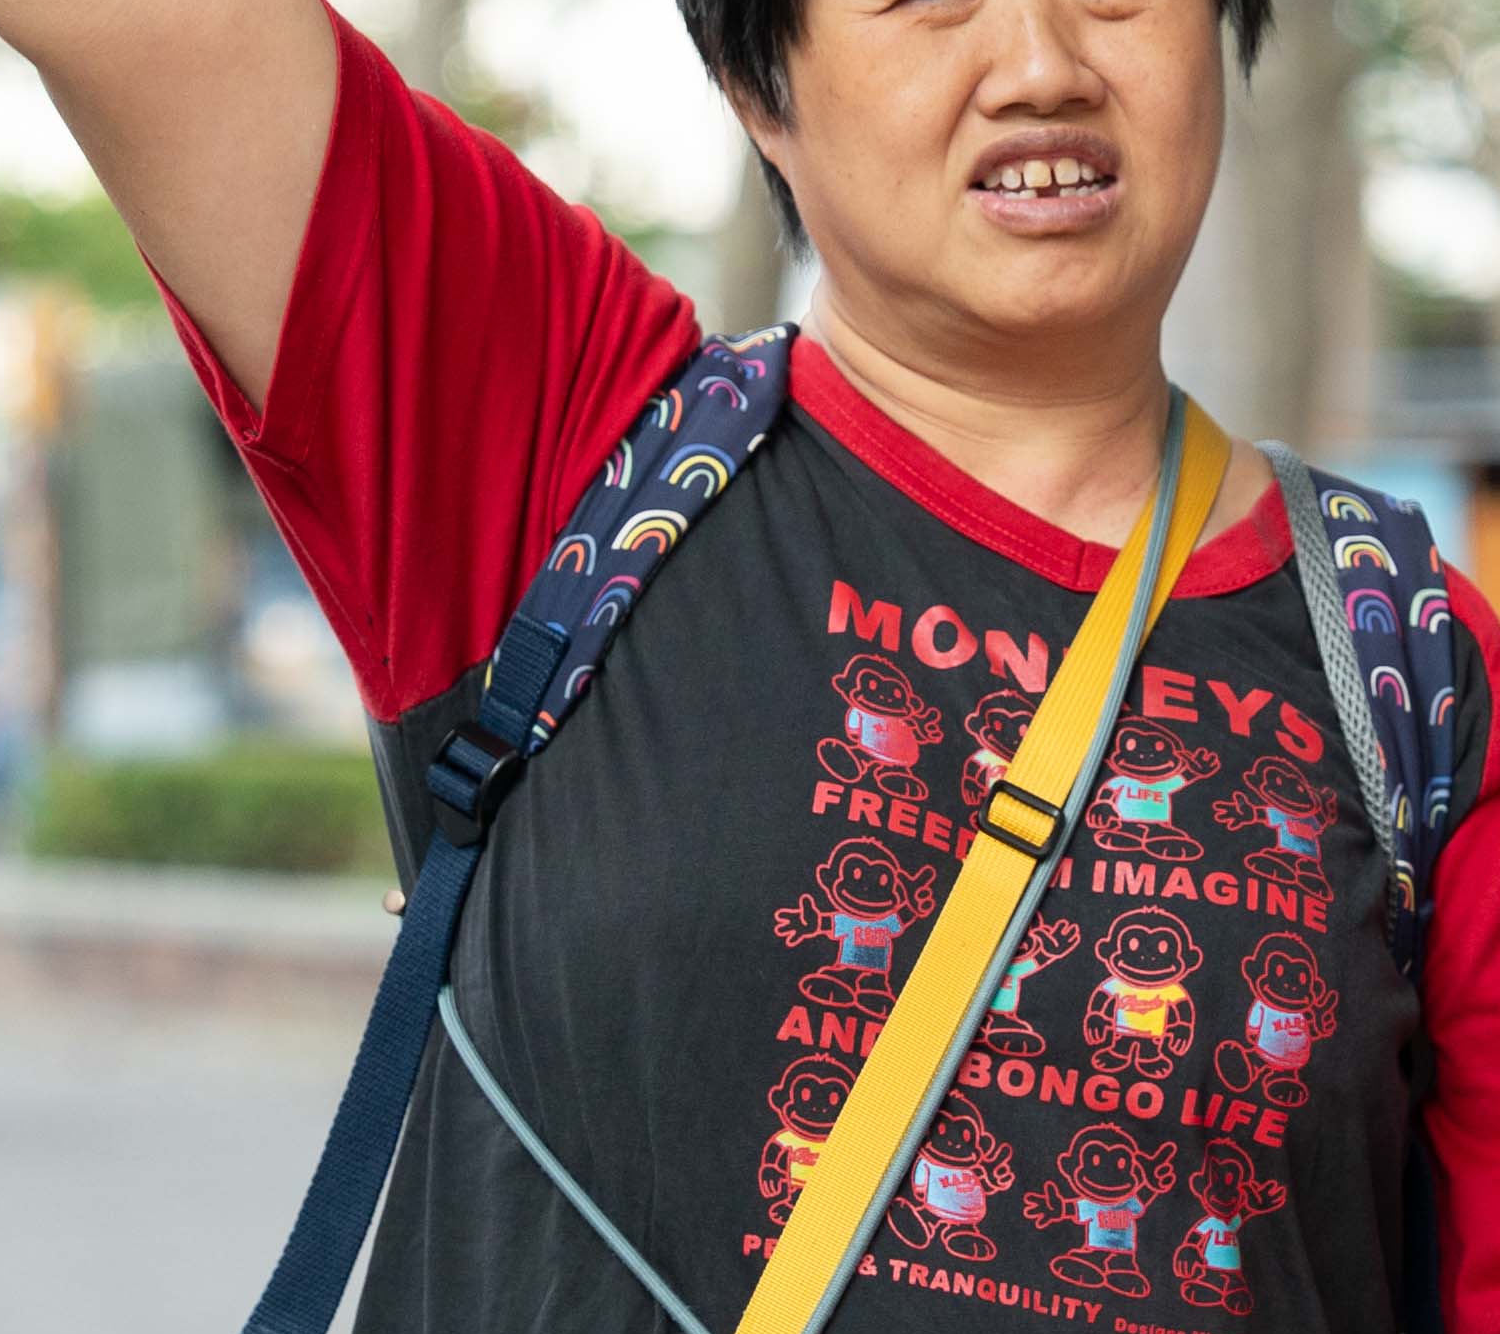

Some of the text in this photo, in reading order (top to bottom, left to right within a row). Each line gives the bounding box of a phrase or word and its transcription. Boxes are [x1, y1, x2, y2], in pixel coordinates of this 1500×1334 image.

[828, 579, 1324, 764] MONEYS
[1127, 786, 1164, 803] LIFE
[812, 780, 1329, 934] FREEM IMAGINE
[956, 1051, 1165, 1119] BONGO
[1180, 1087, 1289, 1148] LIFE
[856, 1254, 1103, 1325] & TRANQUILITY
